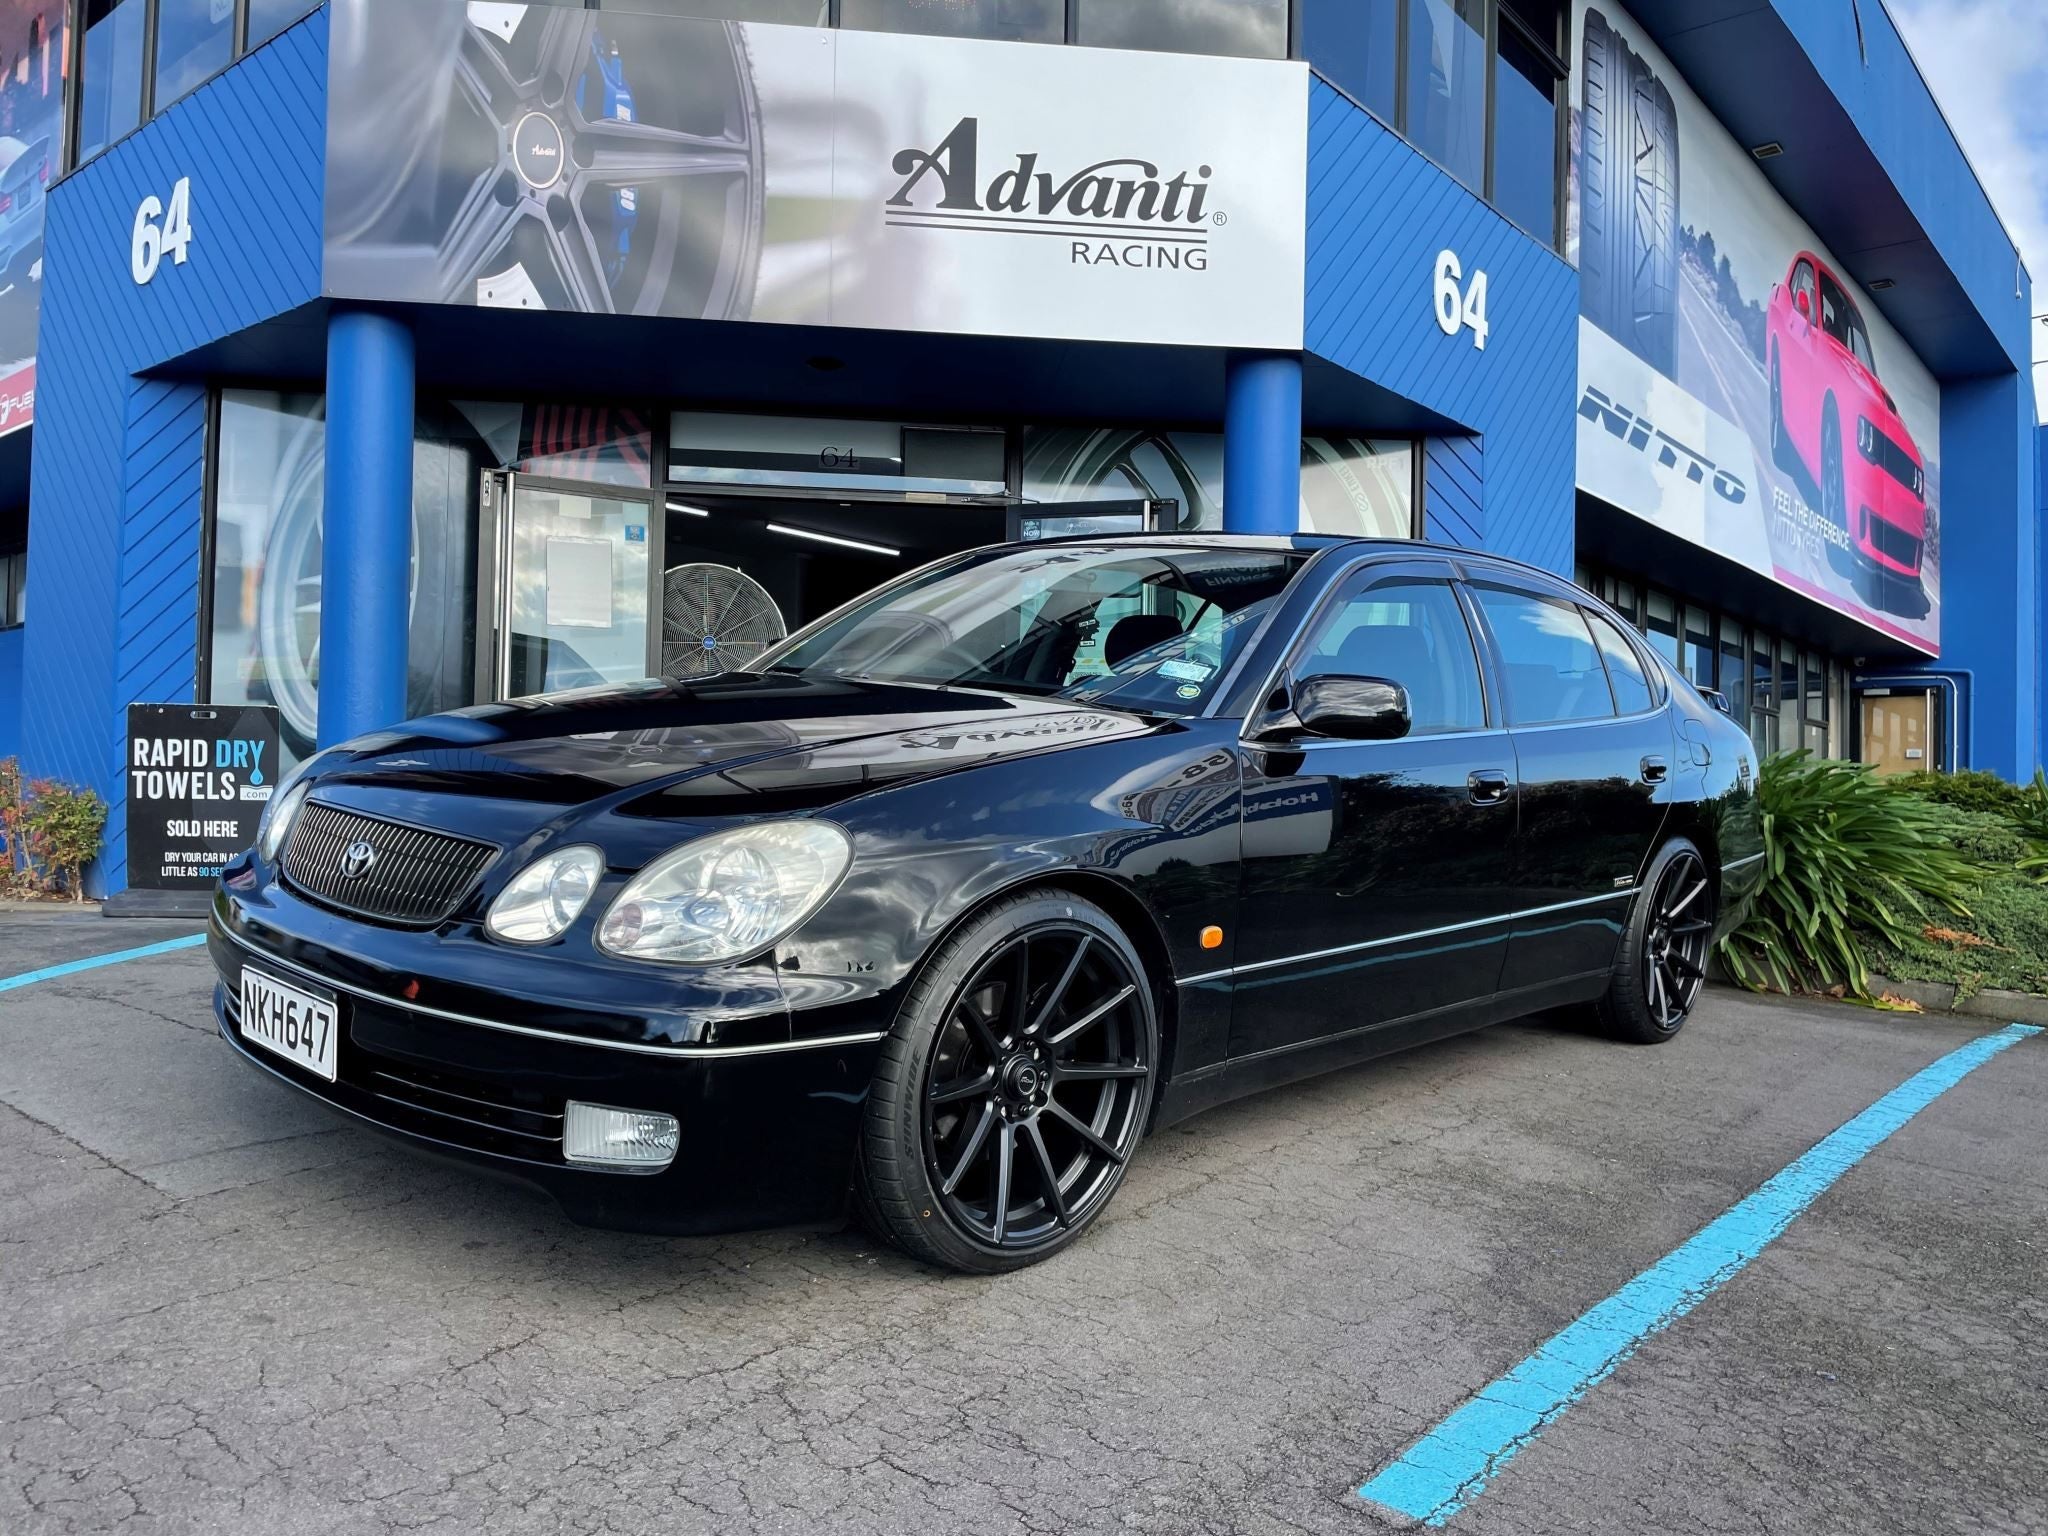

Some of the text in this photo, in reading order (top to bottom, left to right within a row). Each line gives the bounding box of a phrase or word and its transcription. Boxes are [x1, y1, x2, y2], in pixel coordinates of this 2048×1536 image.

[885, 117, 1212, 224] Advanti
[131, 176, 192, 285] 64
[1071, 241, 1208, 271] RACING
[1434, 249, 1489, 352] 64
[820, 446, 859, 468] 64
[1577, 384, 1747, 505] NITTO
[1773, 485, 1851, 552] FEEL THE DIFFERENCE
[133, 738, 265, 774] RAPID DRY
[131, 771, 236, 801] TOWELS
[166, 820, 239, 838] SOLD HERE
[161, 866, 187, 877] LITTLE
[187, 866, 198, 877] AS
[198, 866, 210, 877] 90
[164, 852, 180, 863] DRY
[181, 852, 202, 863] YOUR
[202, 852, 218, 863] CAR
[219, 852, 228, 863] IN
[244, 978, 331, 1064] NKH647
[903, 1045, 922, 1160] SUNWIDE
